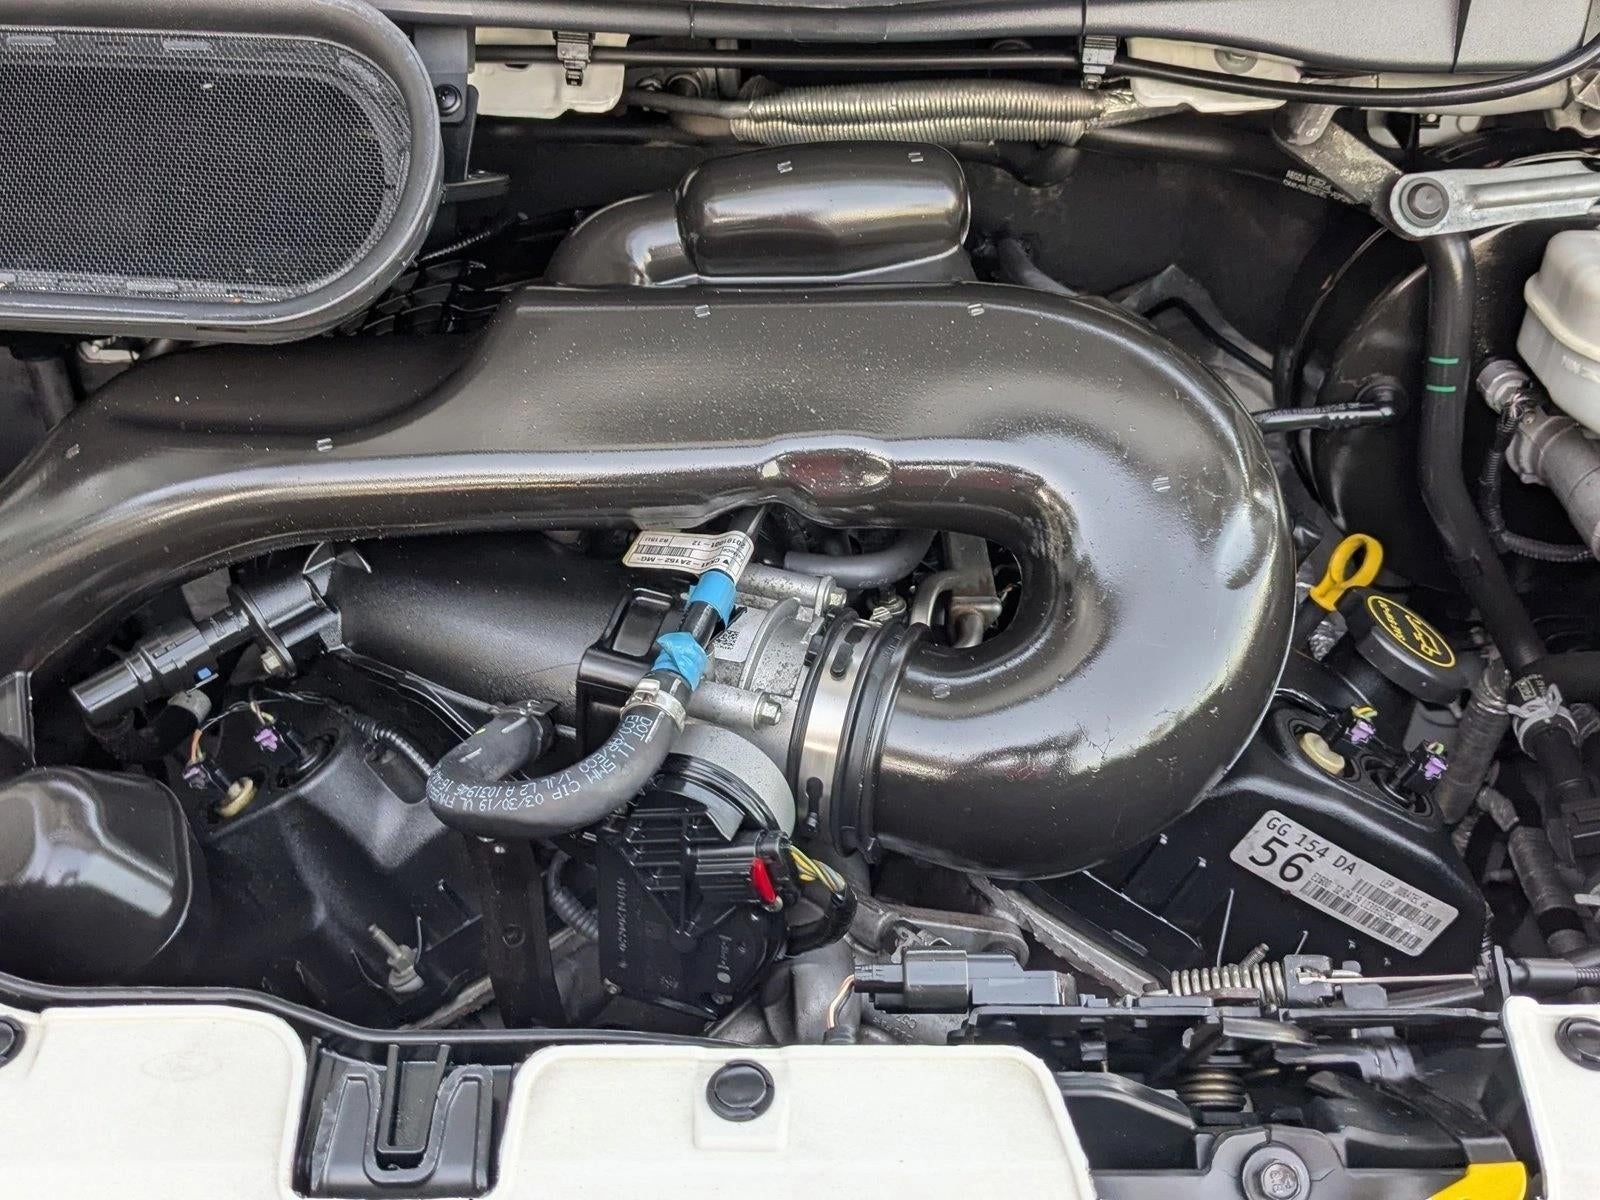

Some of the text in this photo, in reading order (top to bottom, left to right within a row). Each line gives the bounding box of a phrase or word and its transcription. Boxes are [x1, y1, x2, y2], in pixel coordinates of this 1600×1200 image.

[632, 716, 653, 741] DOT
[519, 782, 537, 796] L2
[552, 780, 581, 800] CIP
[479, 792, 545, 812] 03/30/19
[1266, 817, 1357, 876] GG 154 DA
[1248, 836, 1315, 883] 56
